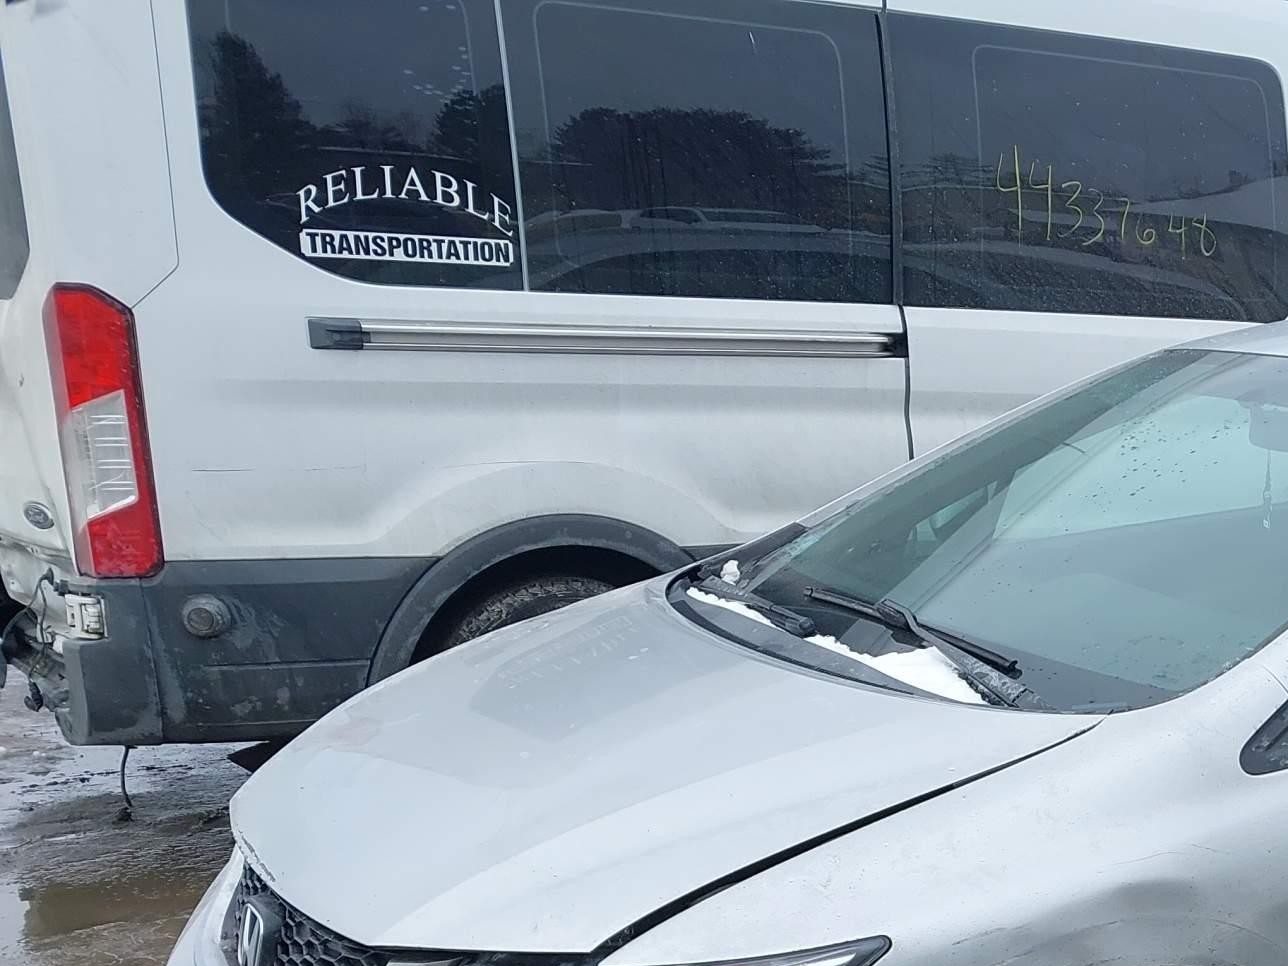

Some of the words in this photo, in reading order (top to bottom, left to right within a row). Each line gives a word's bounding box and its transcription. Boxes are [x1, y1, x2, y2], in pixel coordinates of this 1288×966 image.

[296, 165, 514, 237] RELIABLE
[997, 145, 1216, 258] 44337648
[305, 232, 511, 263] TRANSPORTATION
